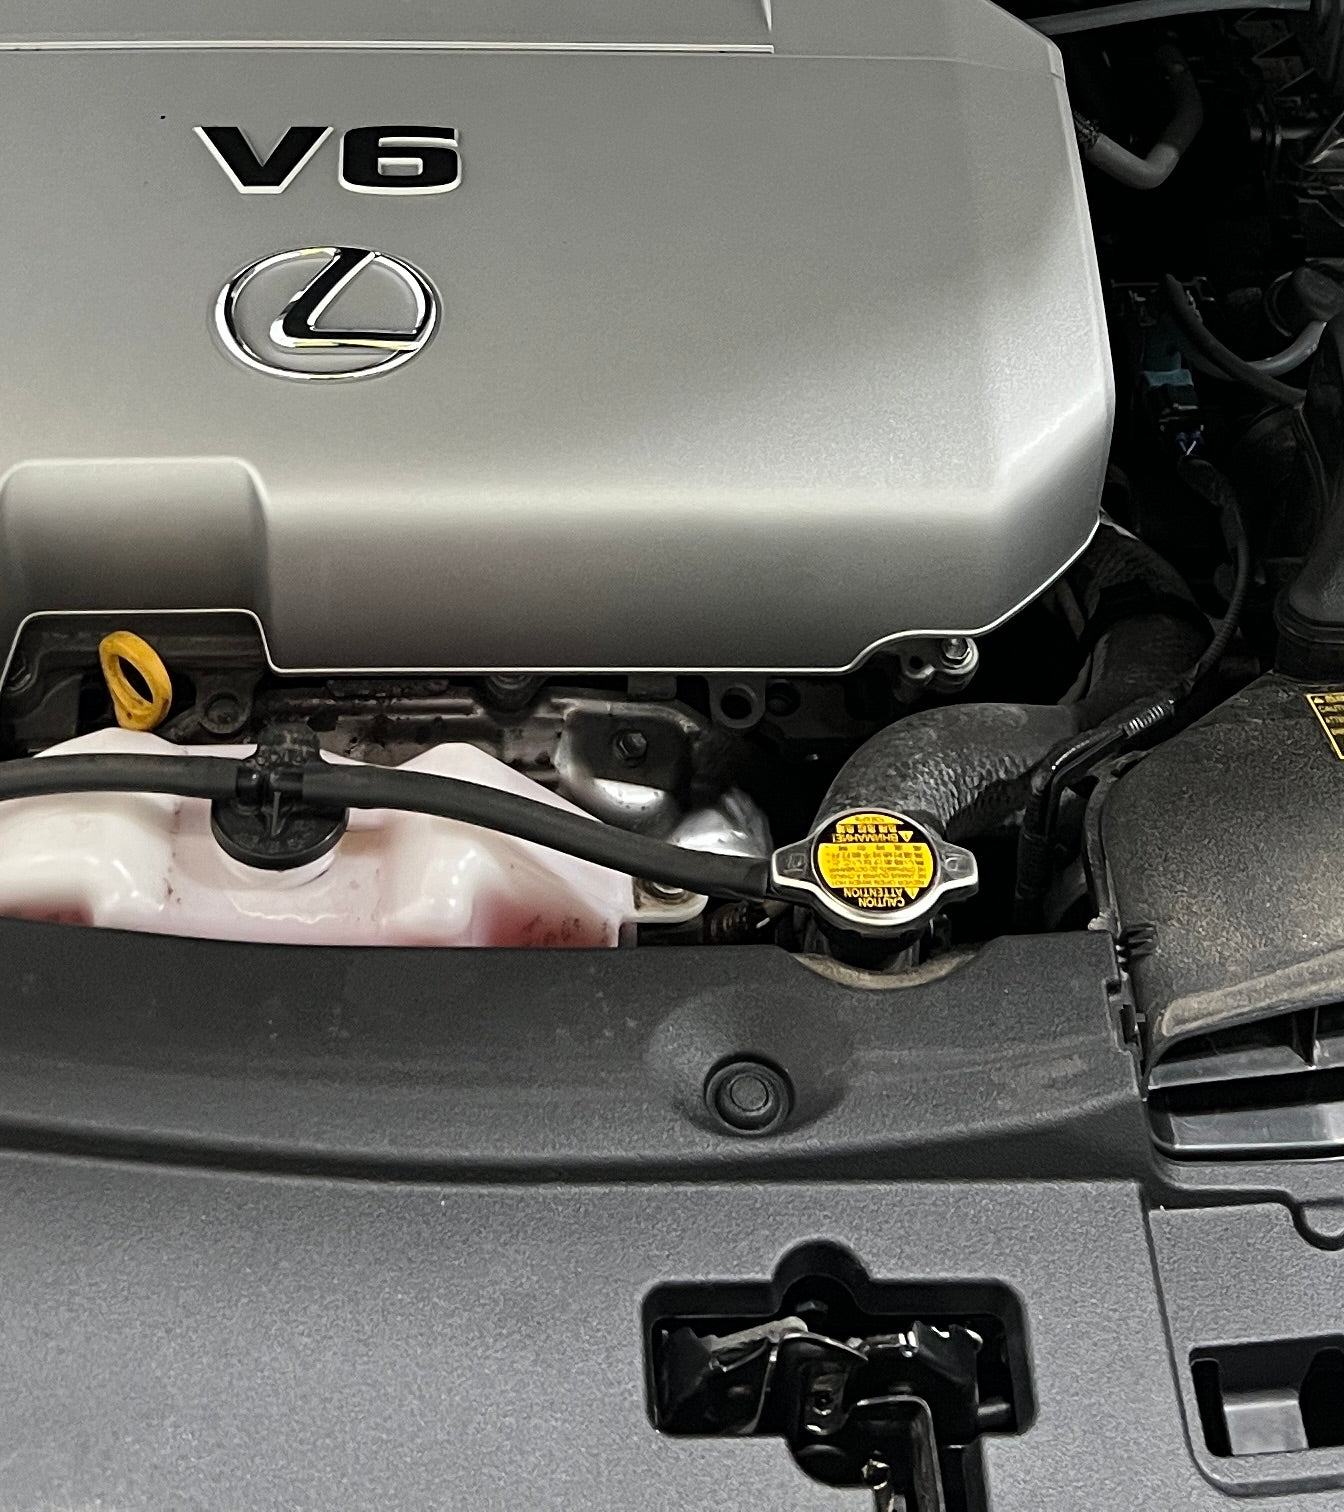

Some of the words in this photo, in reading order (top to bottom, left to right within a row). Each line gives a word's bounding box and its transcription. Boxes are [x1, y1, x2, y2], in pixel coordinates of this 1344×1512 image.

[192, 125, 462, 196] V6
[844, 888, 903, 898] ATTENTION
[859, 897, 905, 907] CAUTION
